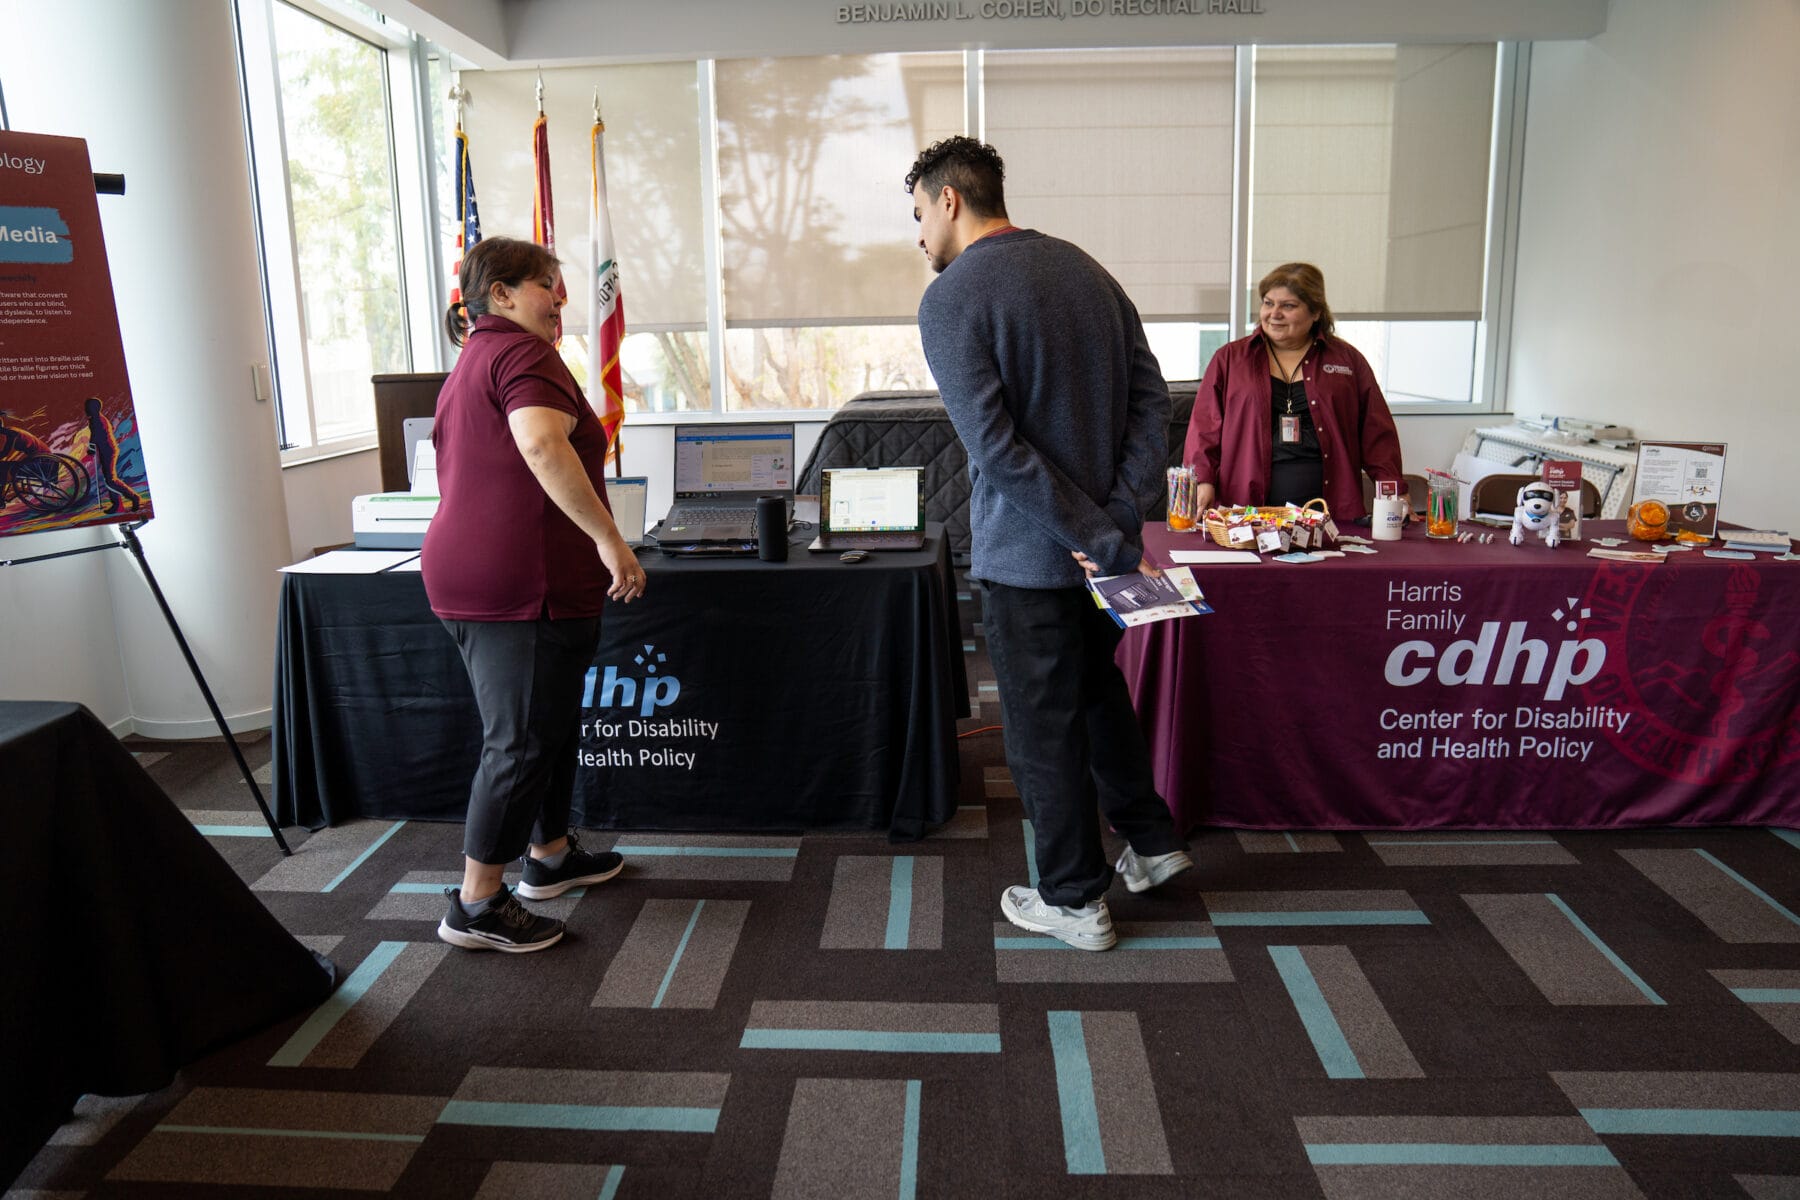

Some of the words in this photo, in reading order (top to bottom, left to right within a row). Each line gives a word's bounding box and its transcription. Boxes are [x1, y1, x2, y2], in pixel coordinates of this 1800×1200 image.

[837, 1, 951, 23] BENJAMIN
[955, 0, 974, 20] L.
[980, 0, 1065, 20] COHEN,
[1072, 0, 1104, 17] DO
[1110, 0, 1204, 16] RECITAL
[1207, 0, 1266, 15] HALL
[0, 152, 46, 174] logy
[72, 354, 90, 362] using
[1387, 581, 1462, 602] Harris
[1386, 609, 1466, 633] Family
[1384, 621, 1607, 701] cdhp
[594, 719, 622, 737] for
[628, 718, 719, 740] Disability
[1379, 709, 1464, 731] Center
[1471, 707, 1508, 730] for
[1514, 706, 1631, 733] Disability
[639, 748, 696, 770] Policy
[1377, 737, 1422, 759] and
[1431, 736, 1510, 759] Health
[1519, 736, 1594, 762] Policy
